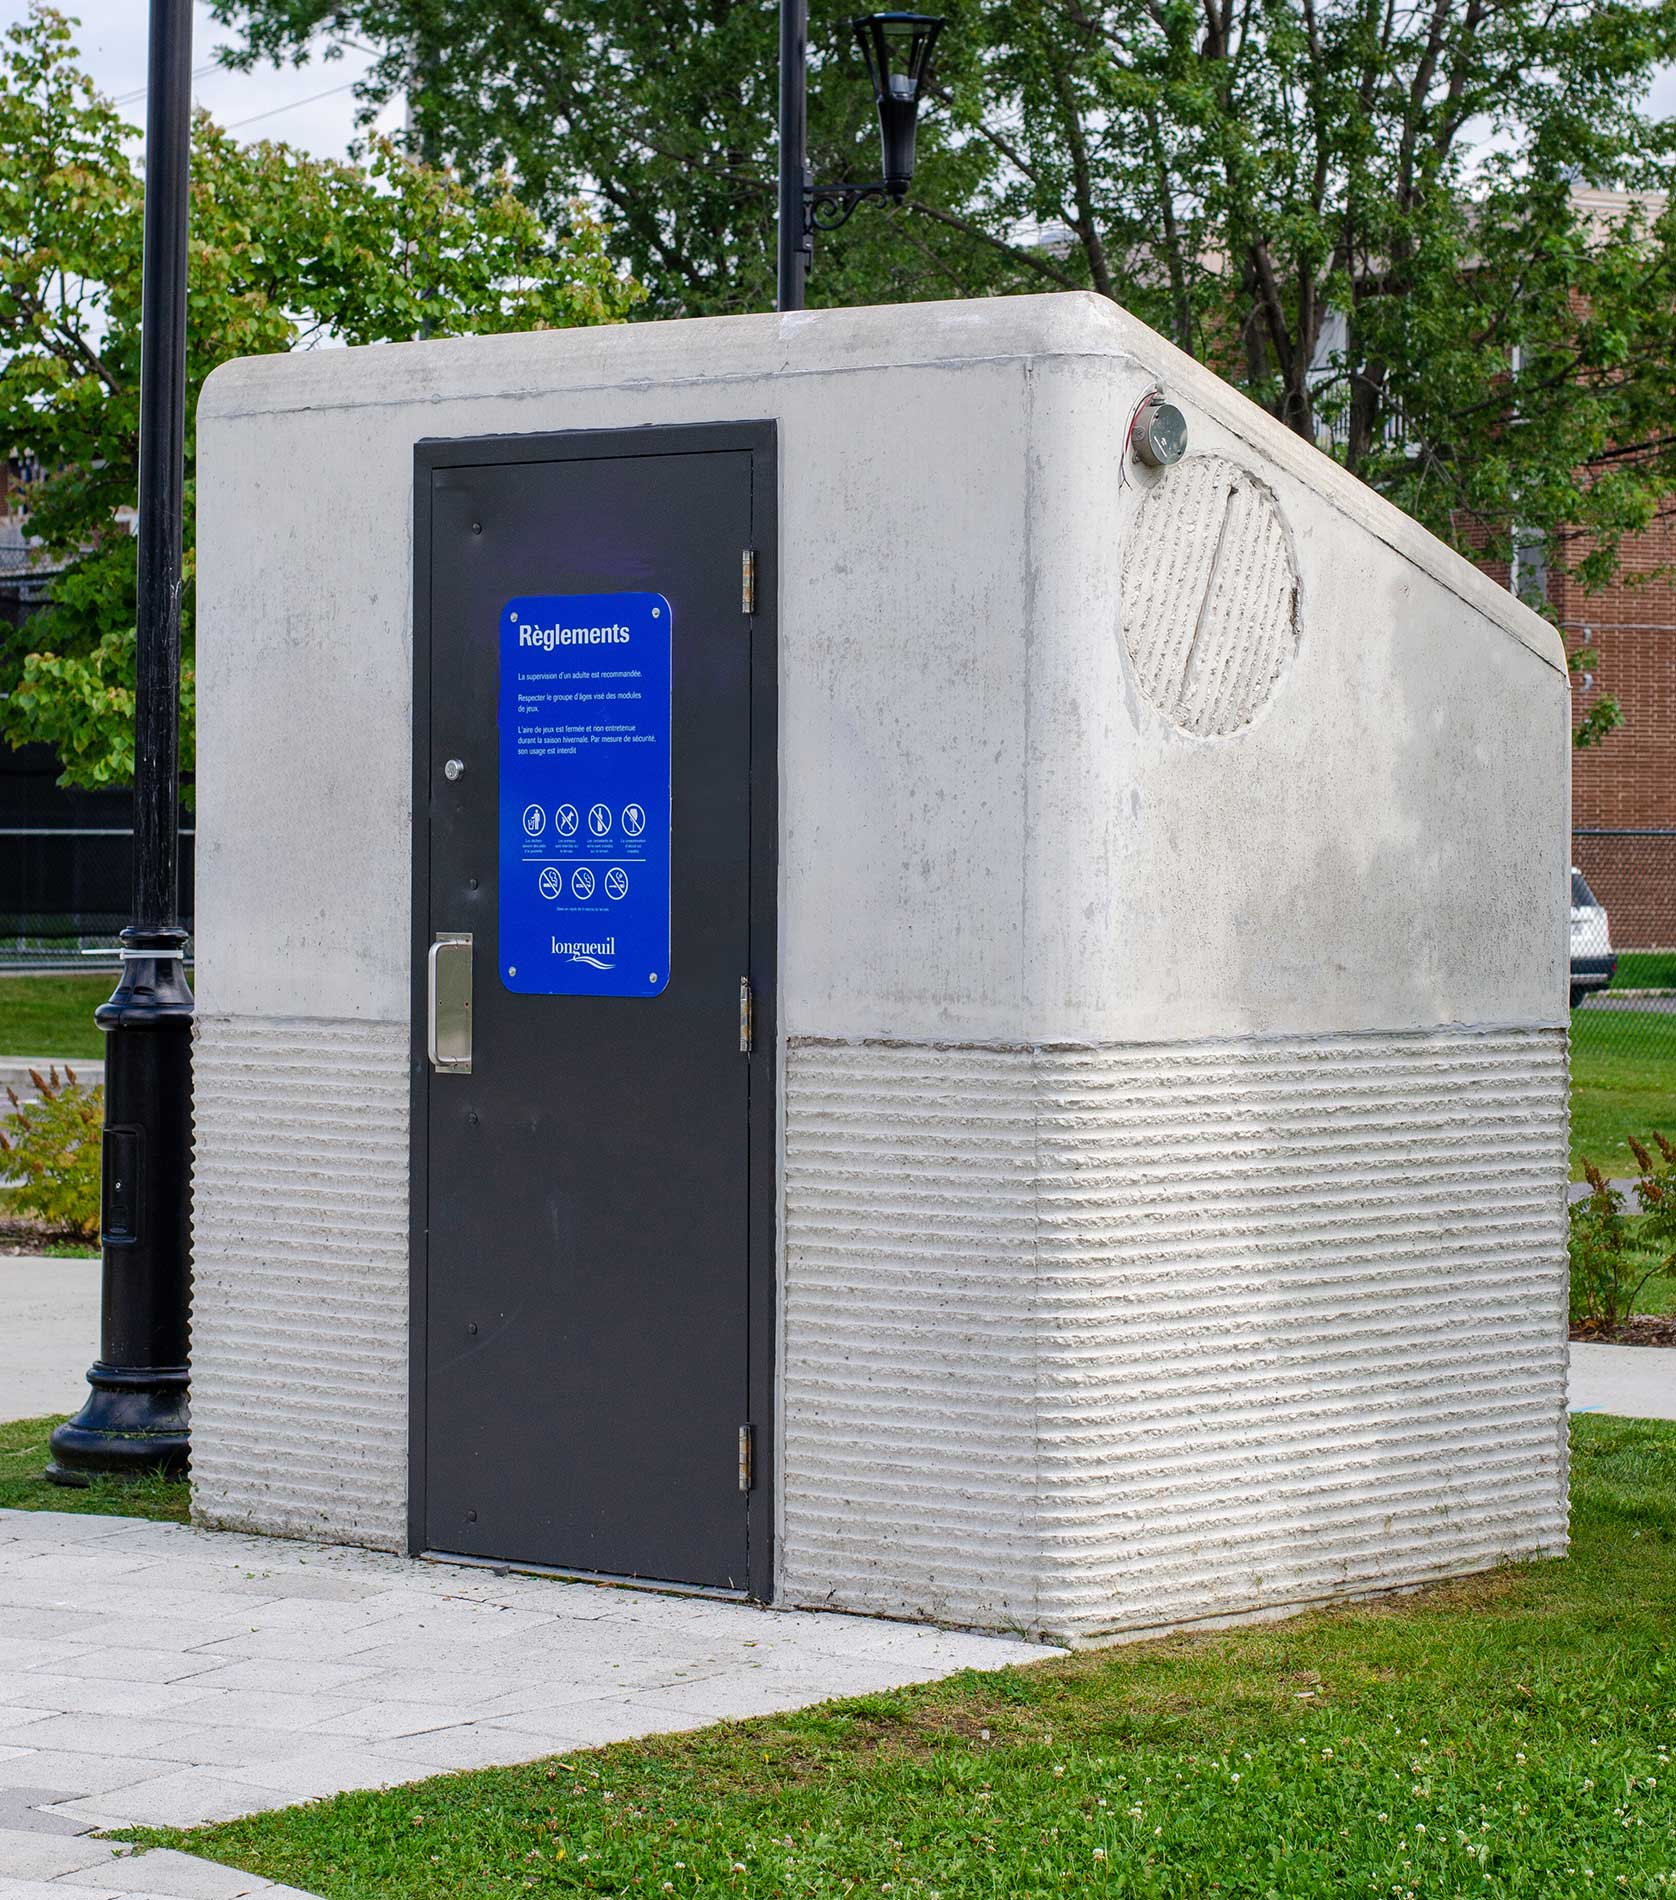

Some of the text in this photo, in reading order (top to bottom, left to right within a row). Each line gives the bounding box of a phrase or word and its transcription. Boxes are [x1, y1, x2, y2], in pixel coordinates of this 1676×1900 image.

[519, 623, 630, 652] Règlements
[518, 669, 643, 682] La supervision d'un adulte est recommandée.
[518, 694, 546, 703] Respecter
[546, 693, 552, 701] le
[553, 694, 573, 703] groupe
[593, 692, 605, 700] visé
[605, 692, 616, 700] des
[617, 691, 642, 700] modules
[518, 704, 525, 712] de
[518, 725, 534, 734] L'aire
[534, 725, 542, 733] de
[542, 725, 555, 735] jeux
[555, 725, 564, 733] est
[565, 724, 585, 733] fermée
[585, 724, 592, 732] et
[605, 724, 636, 732] entretenue
[517, 736, 536, 745] durant
[537, 736, 543, 744] la
[543, 736, 562, 744] saison
[590, 735, 601, 743] Par
[623, 735, 632, 743] de
[529, 747, 546, 756] usage
[556, 746, 577, 754] interdit
[551, 935, 615, 960] longueuil
